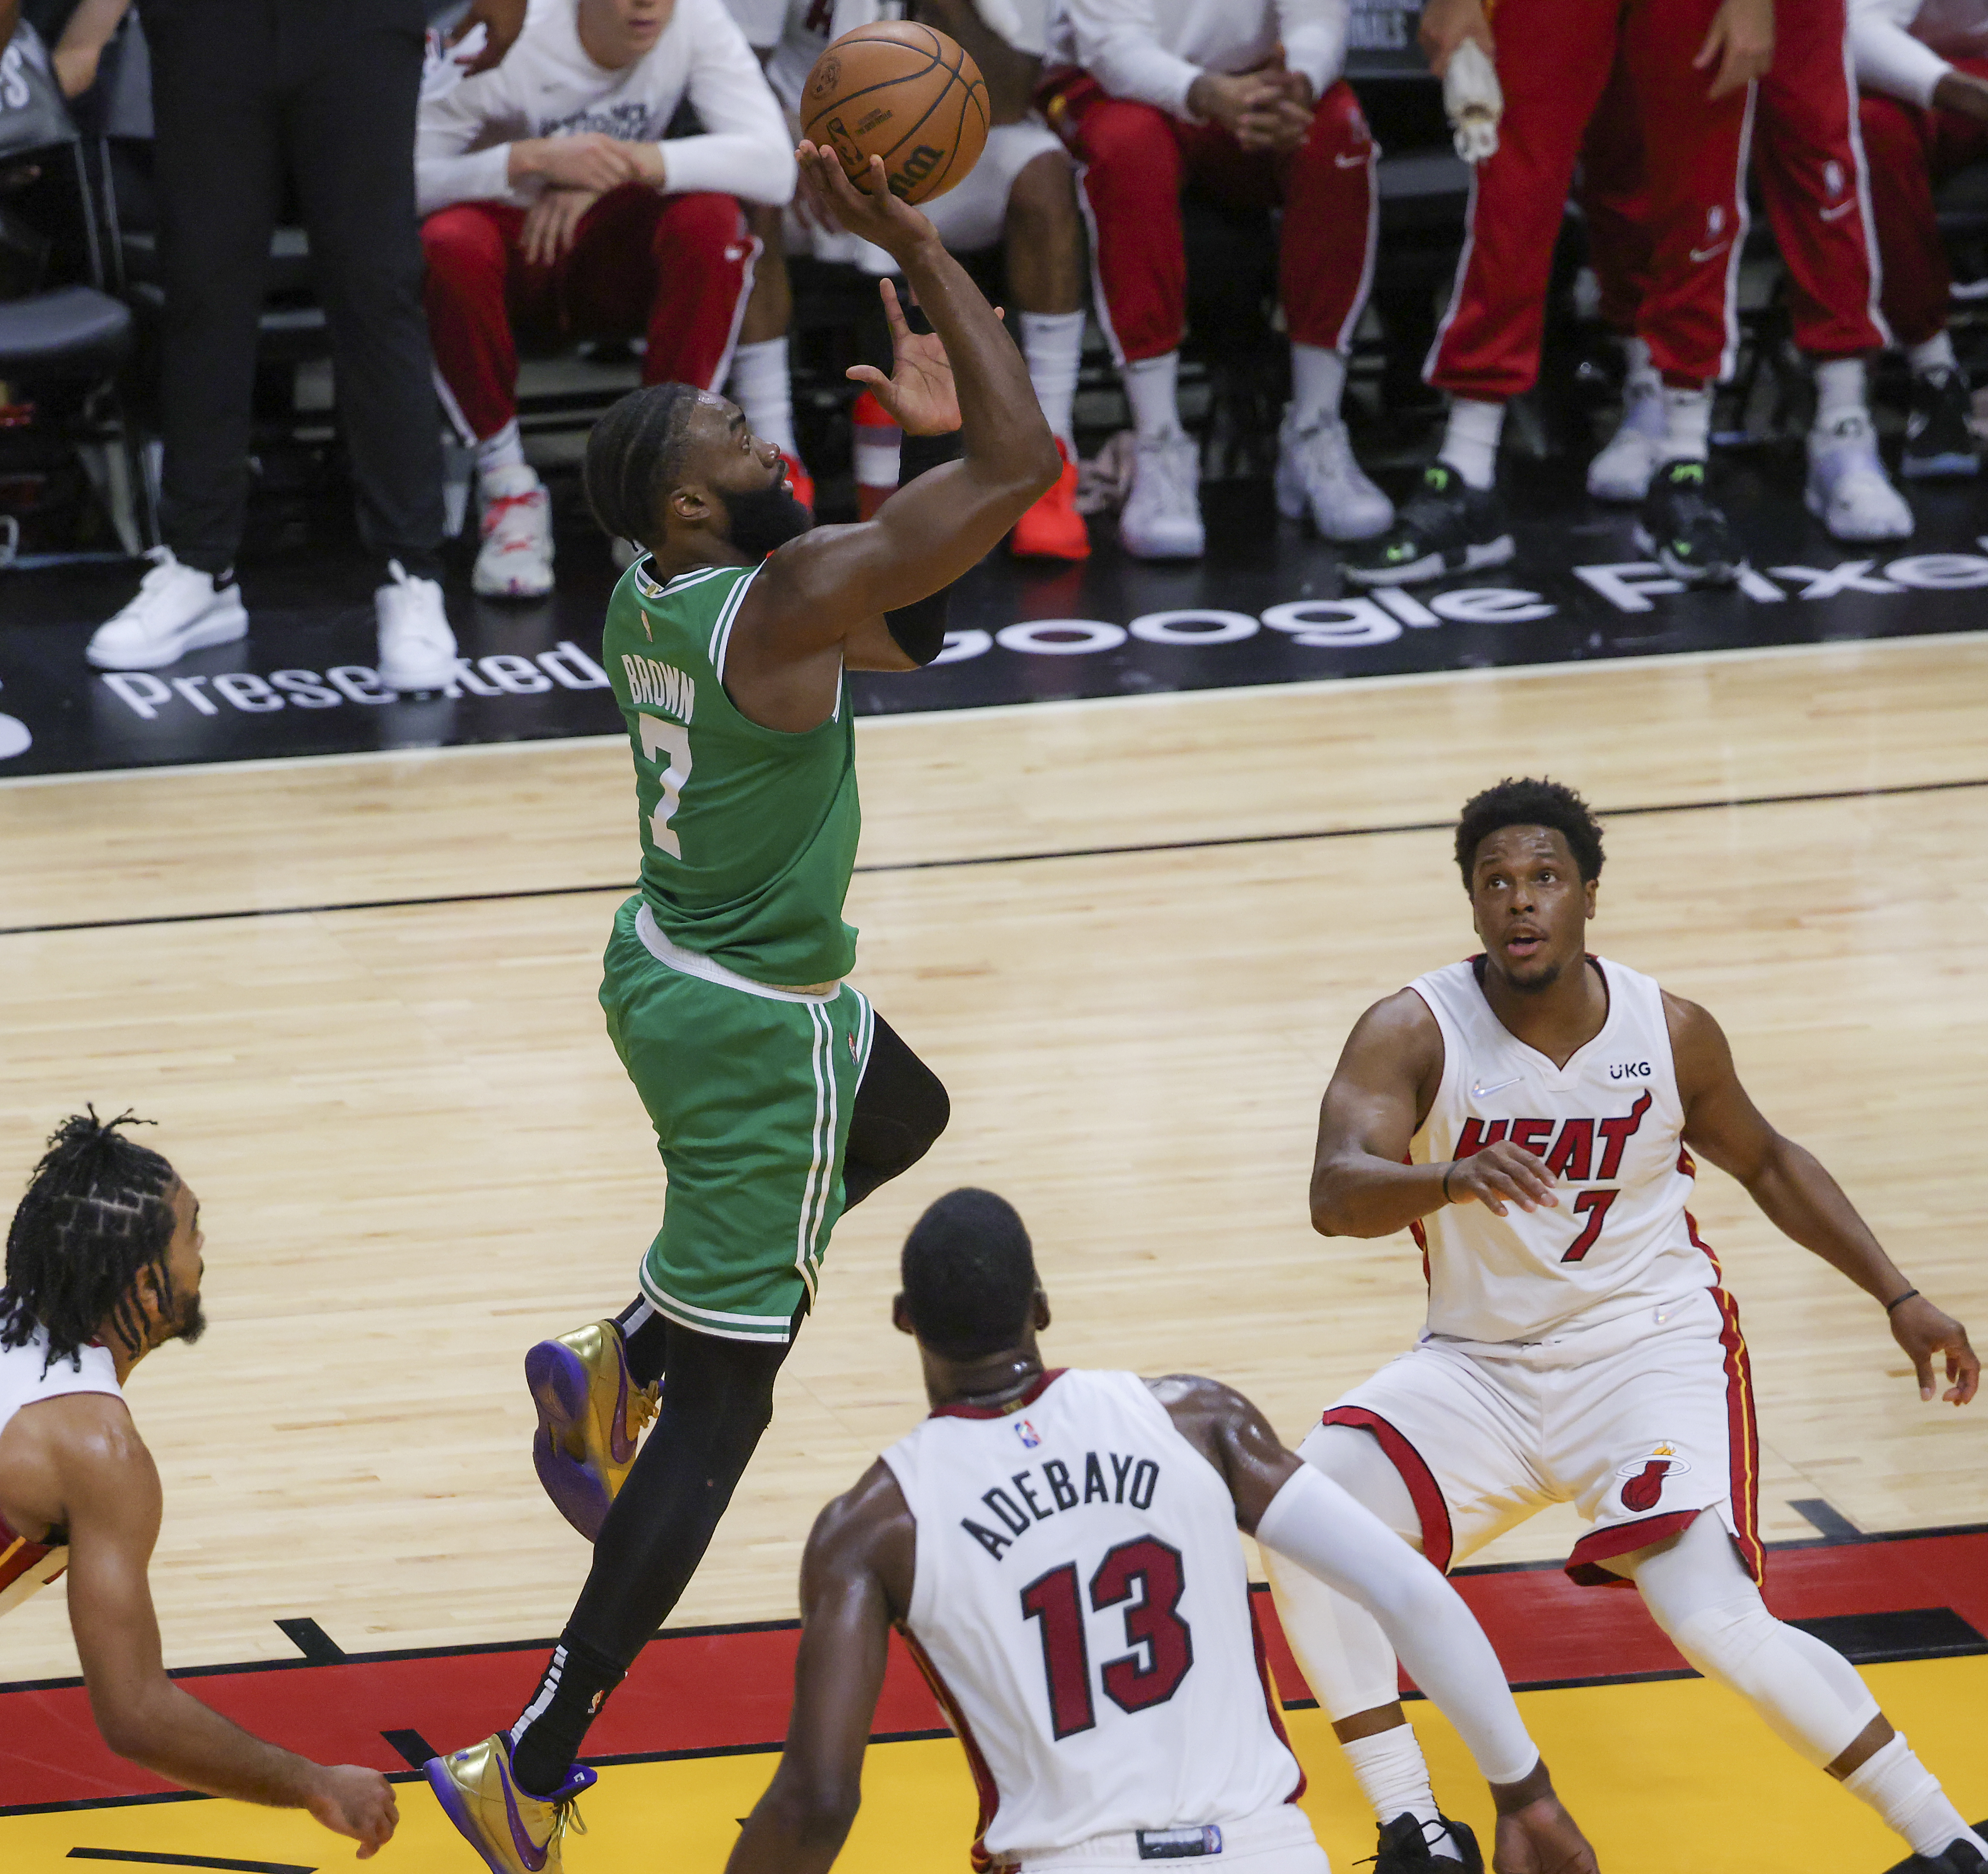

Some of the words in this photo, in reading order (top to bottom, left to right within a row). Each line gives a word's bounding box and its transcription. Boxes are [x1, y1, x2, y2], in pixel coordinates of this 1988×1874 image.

[101, 641, 611, 720] Preseted
[621, 654, 695, 725] BROWN
[639, 712, 693, 860] 7
[1452, 1088, 1652, 1181] HEAT
[1560, 1188, 1621, 1263] 7
[961, 1451, 1160, 1561] ADEBAYO
[1020, 1534, 1194, 1742] 13
